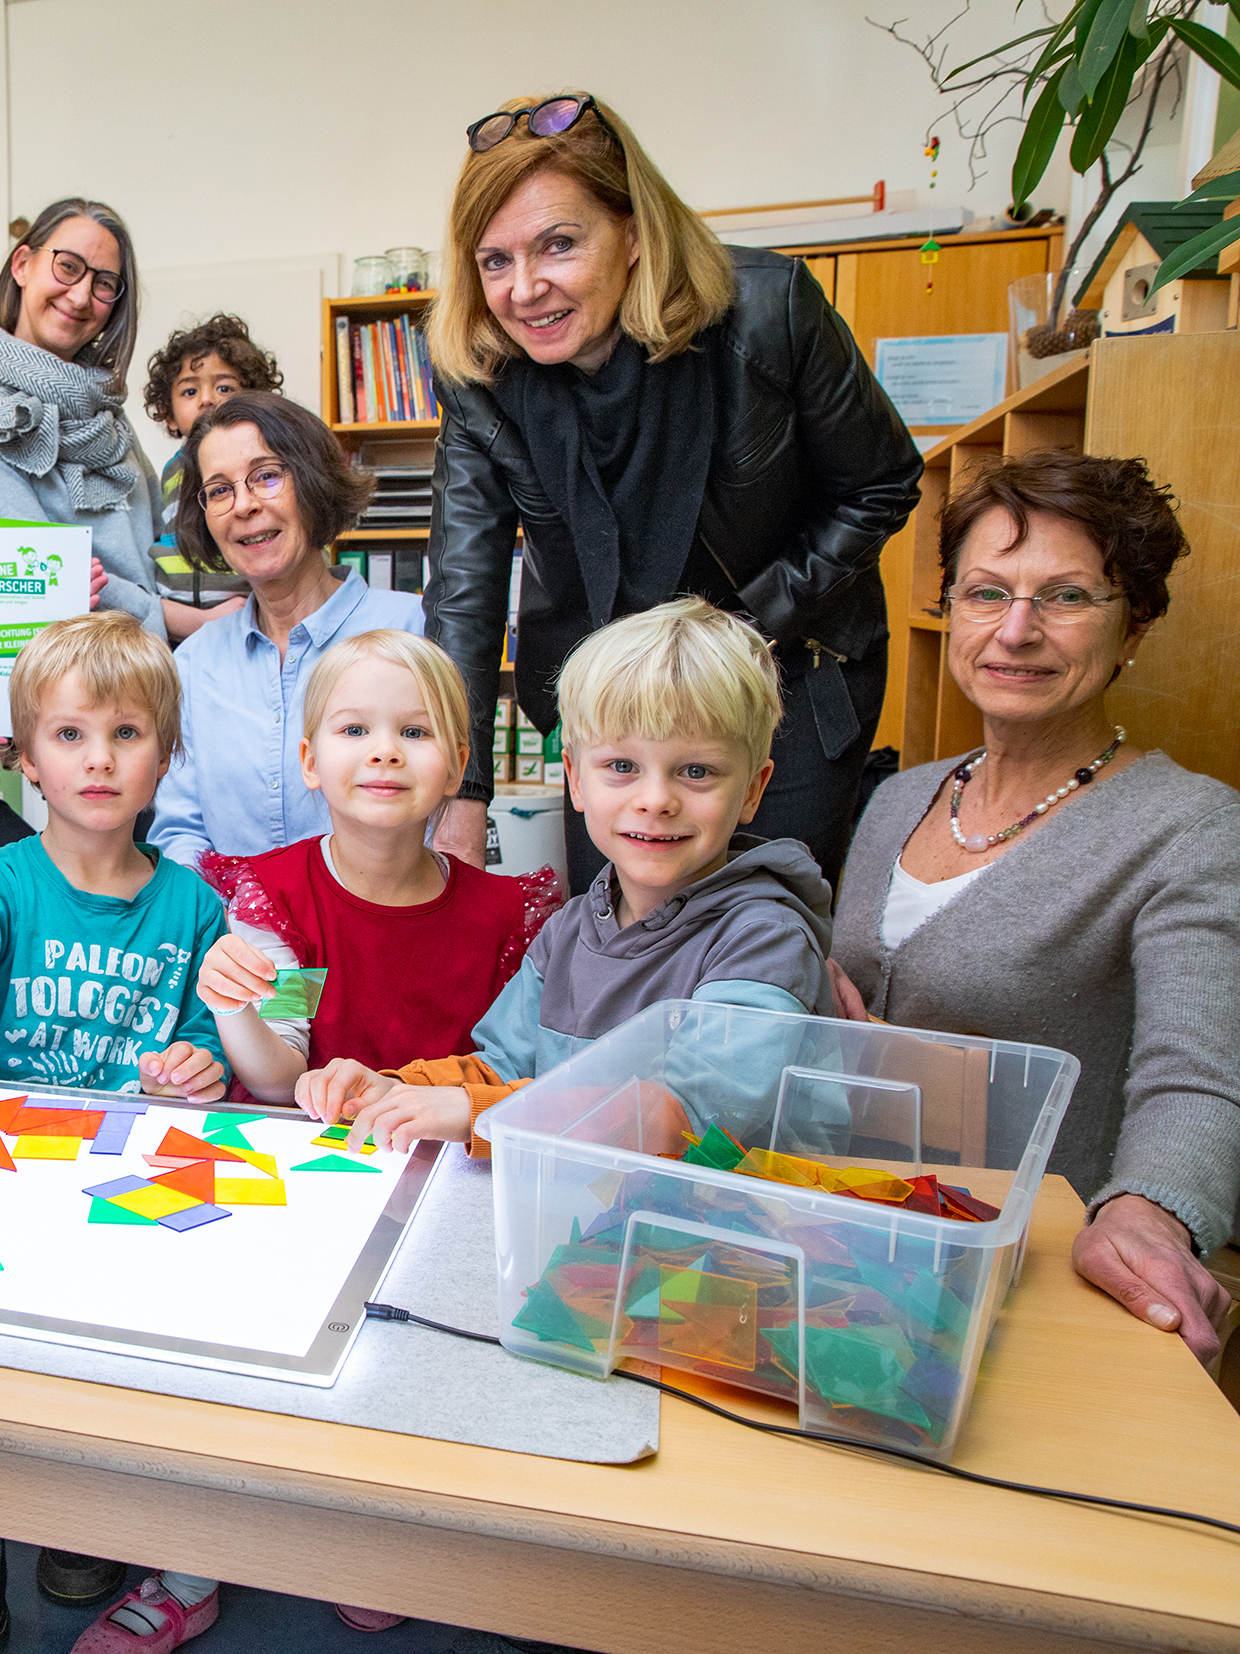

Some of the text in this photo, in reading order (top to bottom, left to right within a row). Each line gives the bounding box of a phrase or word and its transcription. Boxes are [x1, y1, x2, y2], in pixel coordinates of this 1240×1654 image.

[44, 939, 165, 988] PALEON
[28, 1022, 142, 1067] AT WORK
